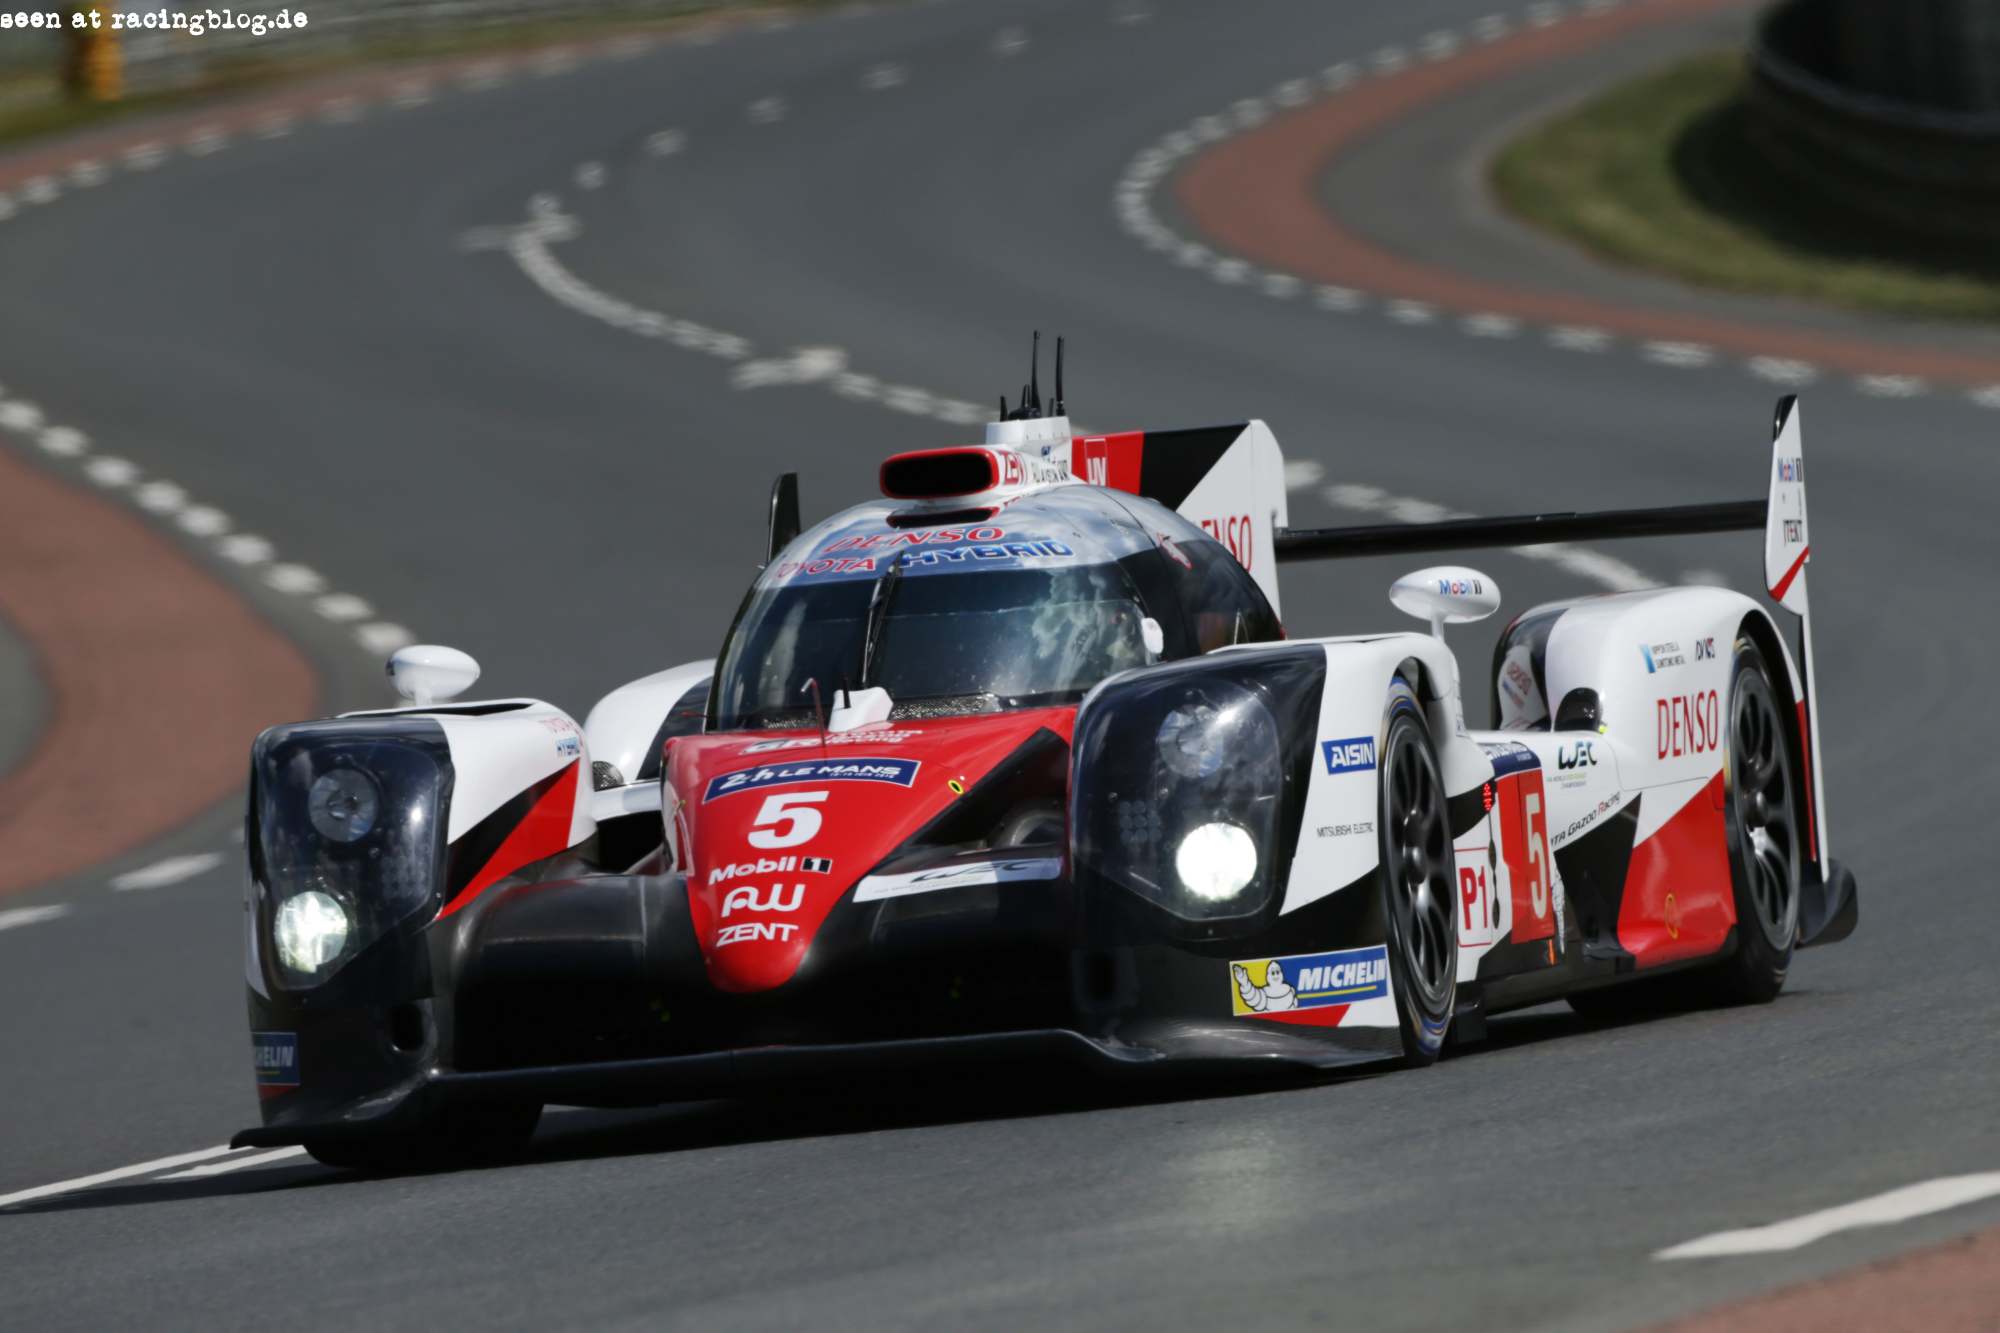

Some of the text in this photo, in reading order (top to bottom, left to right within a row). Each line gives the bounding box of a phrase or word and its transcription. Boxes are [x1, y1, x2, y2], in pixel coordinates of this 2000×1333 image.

[822, 527, 1005, 554] DENSO
[900, 540, 1074, 568] HYBRID
[1657, 689, 1718, 760] DENSO
[1331, 743, 1374, 768] AISIN
[1558, 740, 1598, 770] WEC
[778, 767, 816, 778] LE
[817, 765, 901, 775] MANS
[748, 791, 829, 849] 5
[708, 856, 797, 885] Mobil
[1526, 793, 1547, 919] 5
[1459, 866, 1488, 930] P1
[716, 922, 799, 947] ZENT
[1298, 958, 1387, 991] MICHELIN
